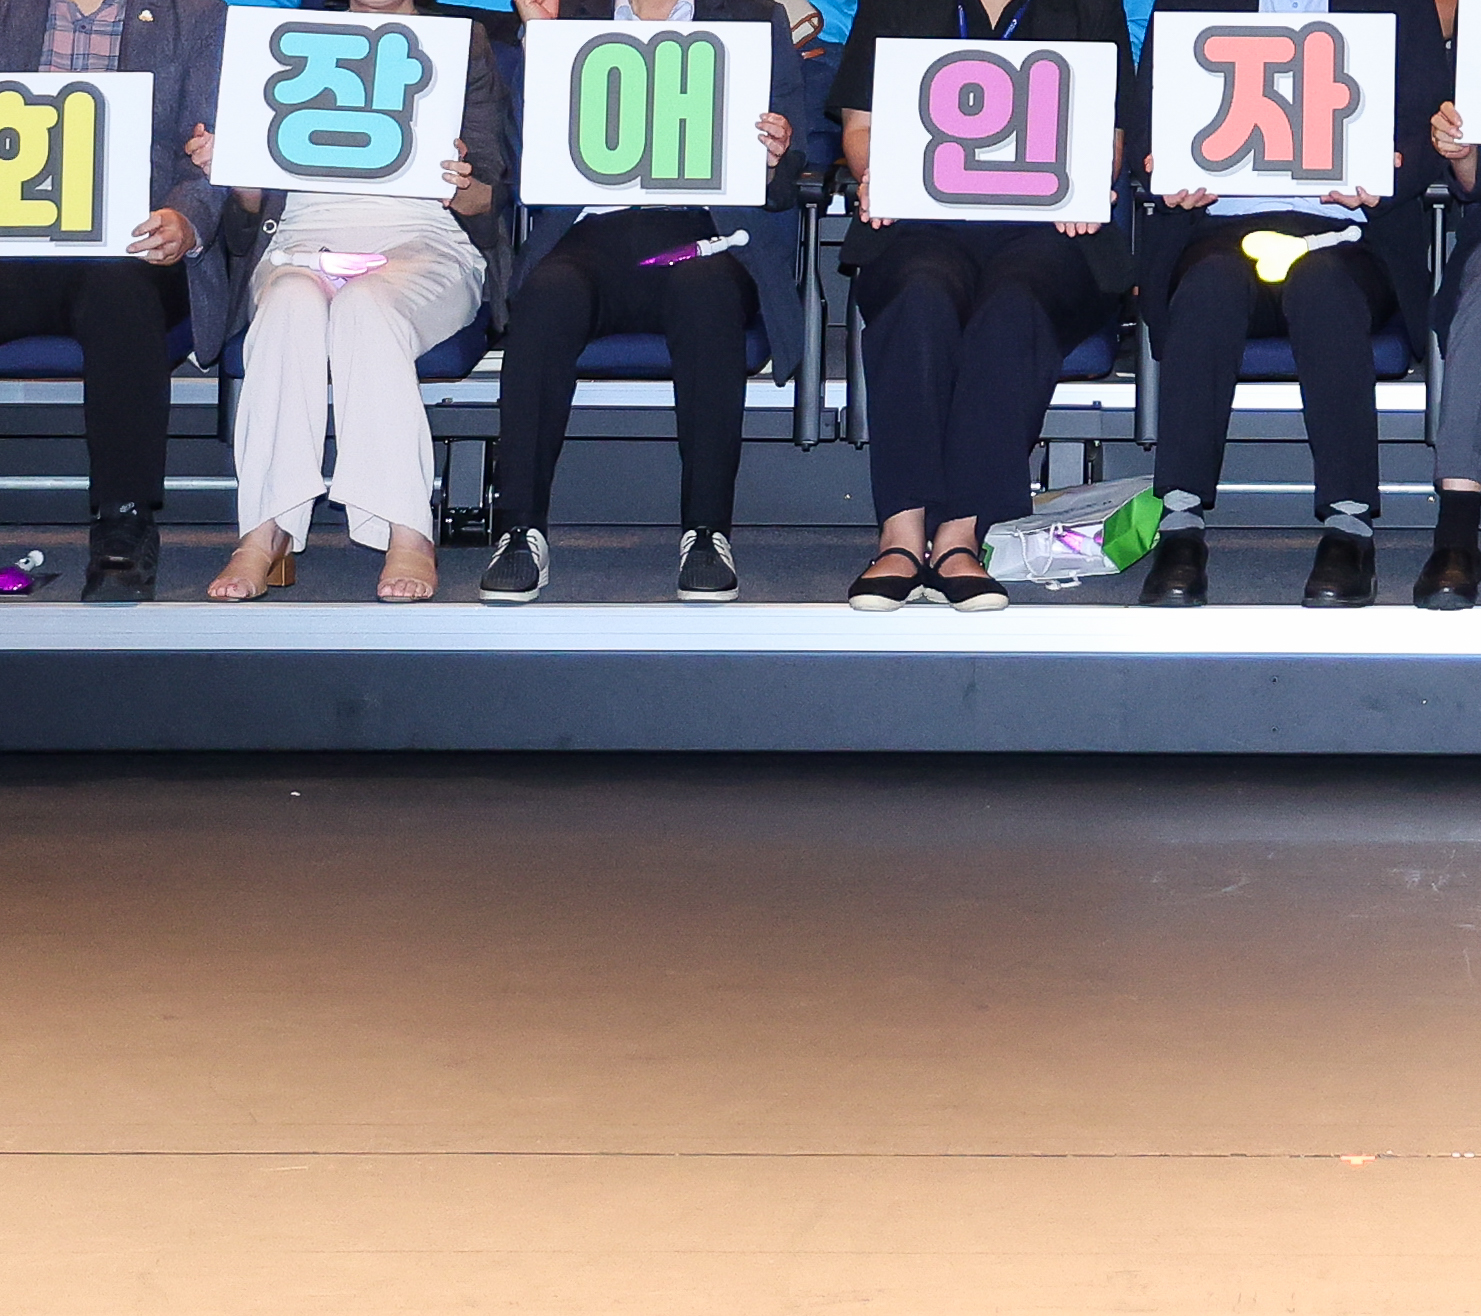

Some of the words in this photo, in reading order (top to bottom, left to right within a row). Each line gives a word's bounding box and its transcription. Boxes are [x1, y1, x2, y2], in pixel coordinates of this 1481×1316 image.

[264, 22, 432, 179] 장
[569, 31, 725, 190] 애
[918, 49, 1071, 206] 인
[1192, 21, 1360, 180] 자
